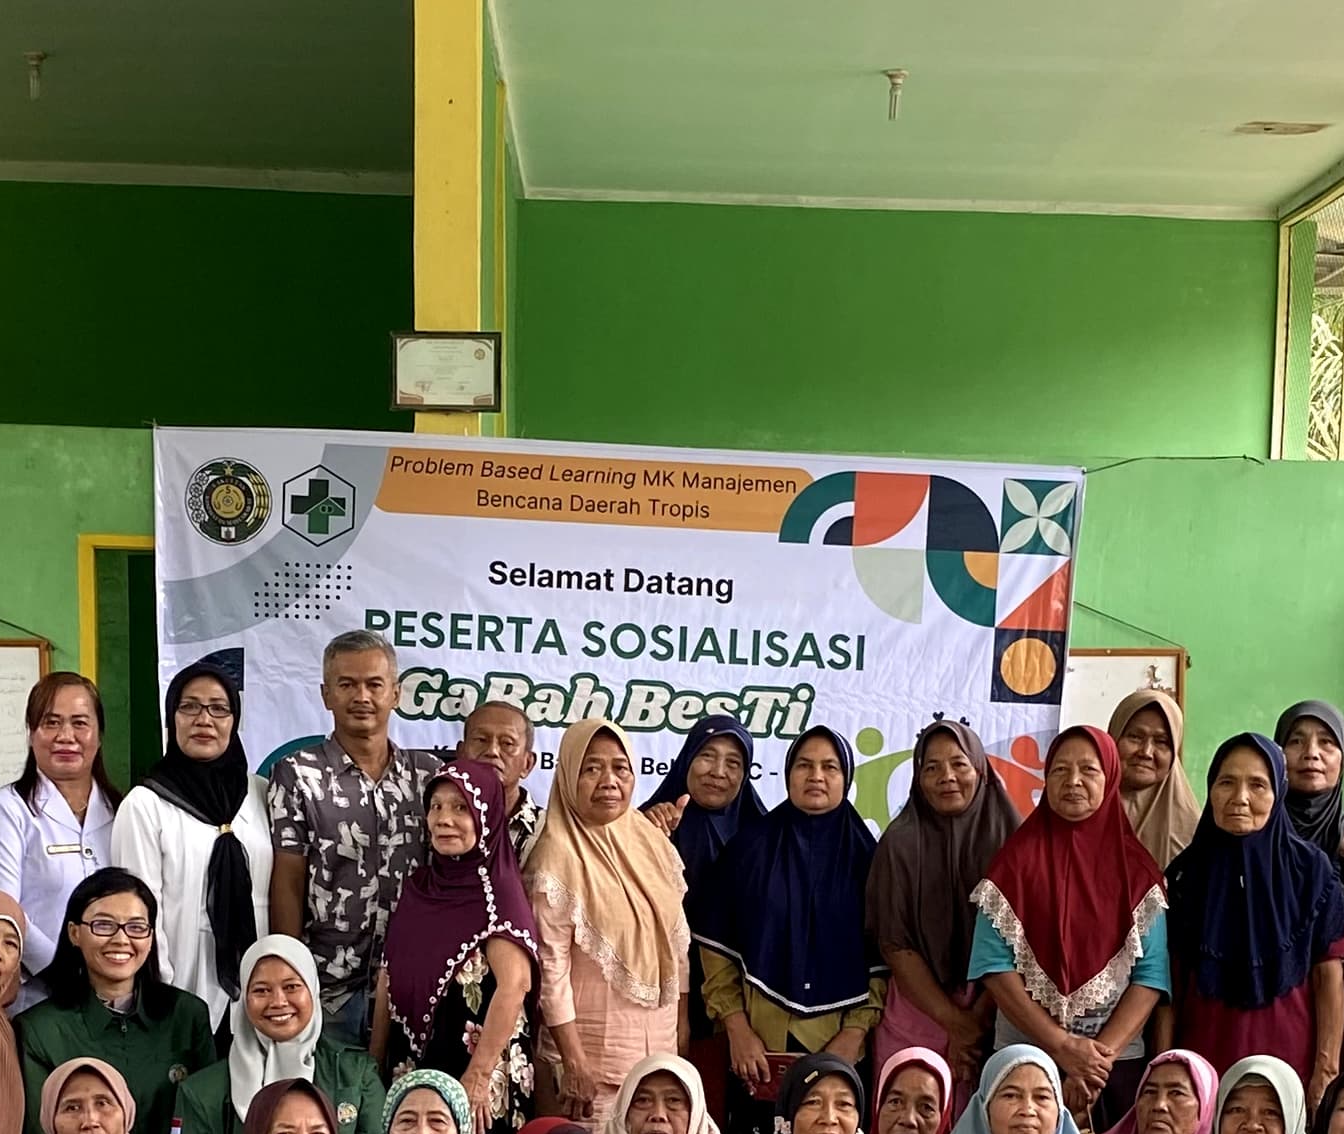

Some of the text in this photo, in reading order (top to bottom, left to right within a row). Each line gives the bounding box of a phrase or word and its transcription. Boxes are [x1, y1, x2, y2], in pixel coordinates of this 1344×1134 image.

[390, 456, 797, 494] Problem Based Learning MK Manajemen
[477, 489, 710, 521] Bencana Daerah Tropis
[488, 560, 734, 604] Selamat Datang
[365, 608, 866, 671] PESERTA SOSIALISASI
[615, 679, 816, 740] BesTi
